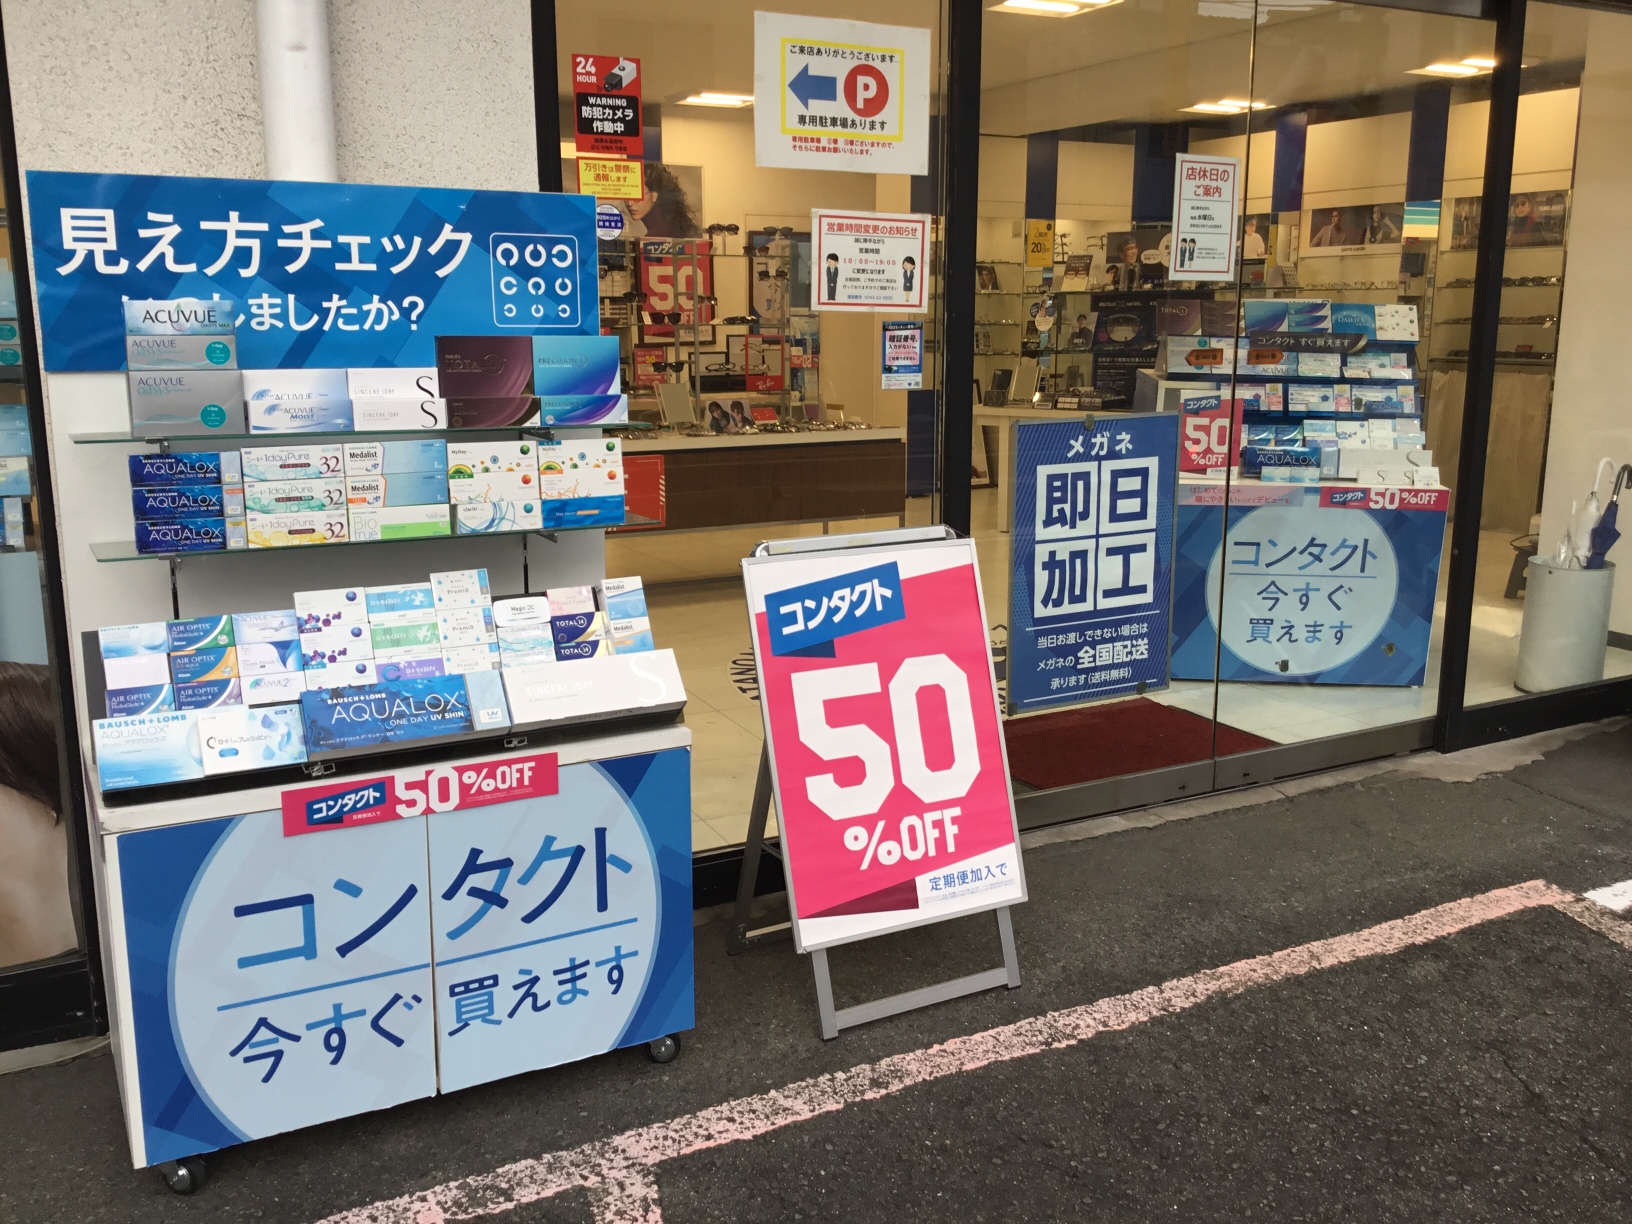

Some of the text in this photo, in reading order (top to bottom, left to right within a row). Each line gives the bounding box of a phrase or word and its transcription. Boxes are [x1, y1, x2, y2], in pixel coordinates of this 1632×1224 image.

[790, 45, 896, 63] ご来店ありがとうございます
[576, 56, 596, 74] 24
[576, 75, 597, 84] HOUR
[857, 75, 877, 109] P
[588, 96, 627, 107] WARNING
[582, 106, 634, 121] 防犯カメラ
[593, 121, 625, 134] 作動中
[797, 114, 888, 132] 専用駐車場あります
[584, 163, 636, 174] 万引きは警察に
[1186, 166, 1229, 182] 店休日の
[593, 173, 628, 183] 通報します
[1194, 184, 1222, 198] ご案内
[827, 222, 918, 236] 営業時間変更のお知らせ
[56, 207, 473, 278] 見え方チェック
[649, 266, 703, 310] 50
[142, 309, 218, 323] ACUVUE
[131, 339, 177, 349] ACUVUE
[1257, 336, 1351, 348] コンタクト すぐ買えます
[137, 377, 185, 387] ACUVUE
[1187, 399, 1218, 409] コンタクト
[420, 400, 438, 429] S
[1184, 417, 1234, 453] 50
[1067, 432, 1133, 458] メガネ
[349, 450, 378, 459] Medalist
[1191, 454, 1225, 465] %OFF
[1257, 454, 1316, 466] AQUALOX
[143, 462, 217, 474] AQUALOX
[319, 456, 341, 474] 32
[351, 484, 379, 492] Medalist
[146, 495, 219, 508] AQUALOX
[323, 489, 344, 507] 32
[1042, 466, 1150, 529] 即日
[1332, 488, 1438, 509] コンタクト 50 %OFF
[324, 522, 346, 540] 32
[353, 516, 377, 530] Bio
[149, 528, 222, 541] AQUALOX
[354, 531, 377, 540] true
[1231, 537, 1378, 573] コンタクト
[1041, 543, 1148, 609] 加工
[1257, 580, 1353, 611] 今すぐ
[780, 578, 892, 636] コンタクト
[1037, 622, 1148, 649] 当日お渡しできない場合は
[1246, 618, 1352, 645] 買えます
[255, 678, 289, 688] ACUVUE 2
[629, 653, 667, 703] S
[1050, 667, 1132, 690] 承ります(送料無料)
[525, 682, 569, 697] SINCERE
[331, 692, 462, 724] AQUALOX
[390, 711, 464, 727] ONE DAY UV SHIN
[101, 726, 166, 740] AQUALOX
[124, 736, 166, 745] アクアロックス
[791, 653, 981, 821] 50
[312, 787, 381, 819] コンタクト
[394, 768, 459, 818] 50
[462, 762, 536, 795] %OFF
[352, 811, 381, 820] 定期便加入で
[844, 807, 961, 870] %OFF
[929, 862, 1007, 892] 定期便加入で
[234, 827, 632, 968] コンタクト
